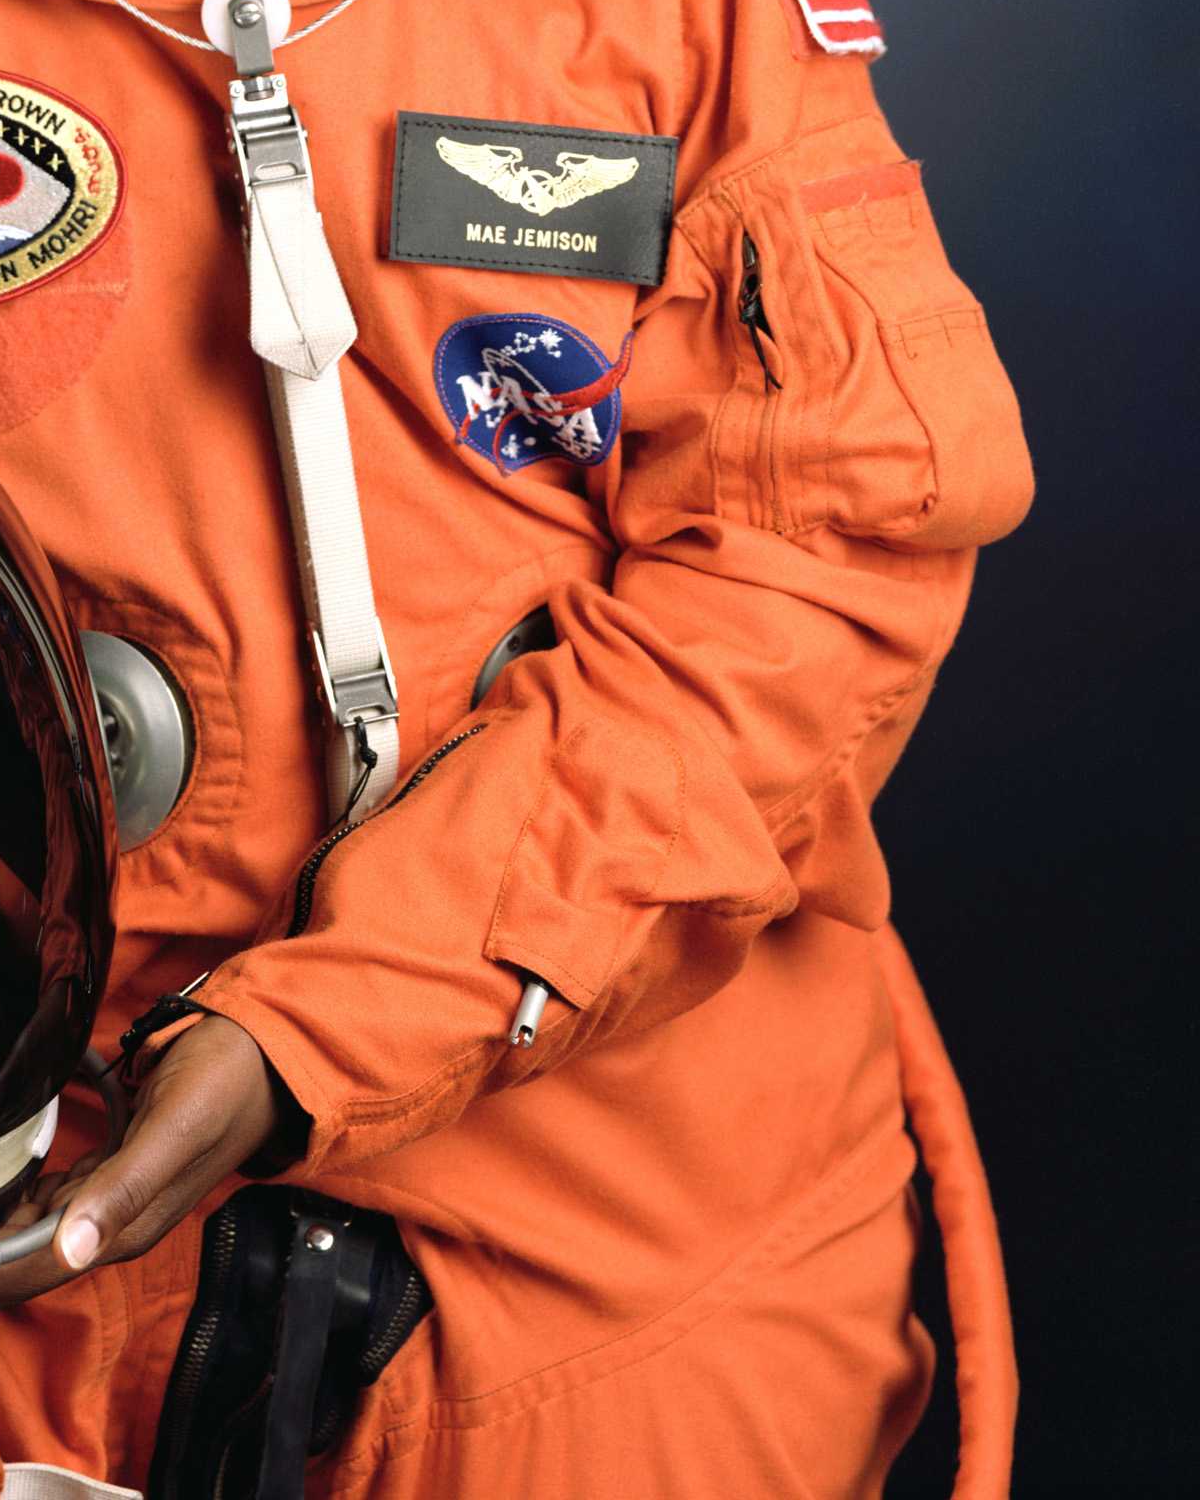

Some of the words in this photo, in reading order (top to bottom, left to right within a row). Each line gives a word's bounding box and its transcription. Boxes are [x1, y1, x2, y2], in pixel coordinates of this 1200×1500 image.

[28, 200, 98, 270] MOHRI
[465, 223, 507, 246] MAE
[513, 227, 598, 253] JEMISON
[456, 371, 604, 458] NASA
